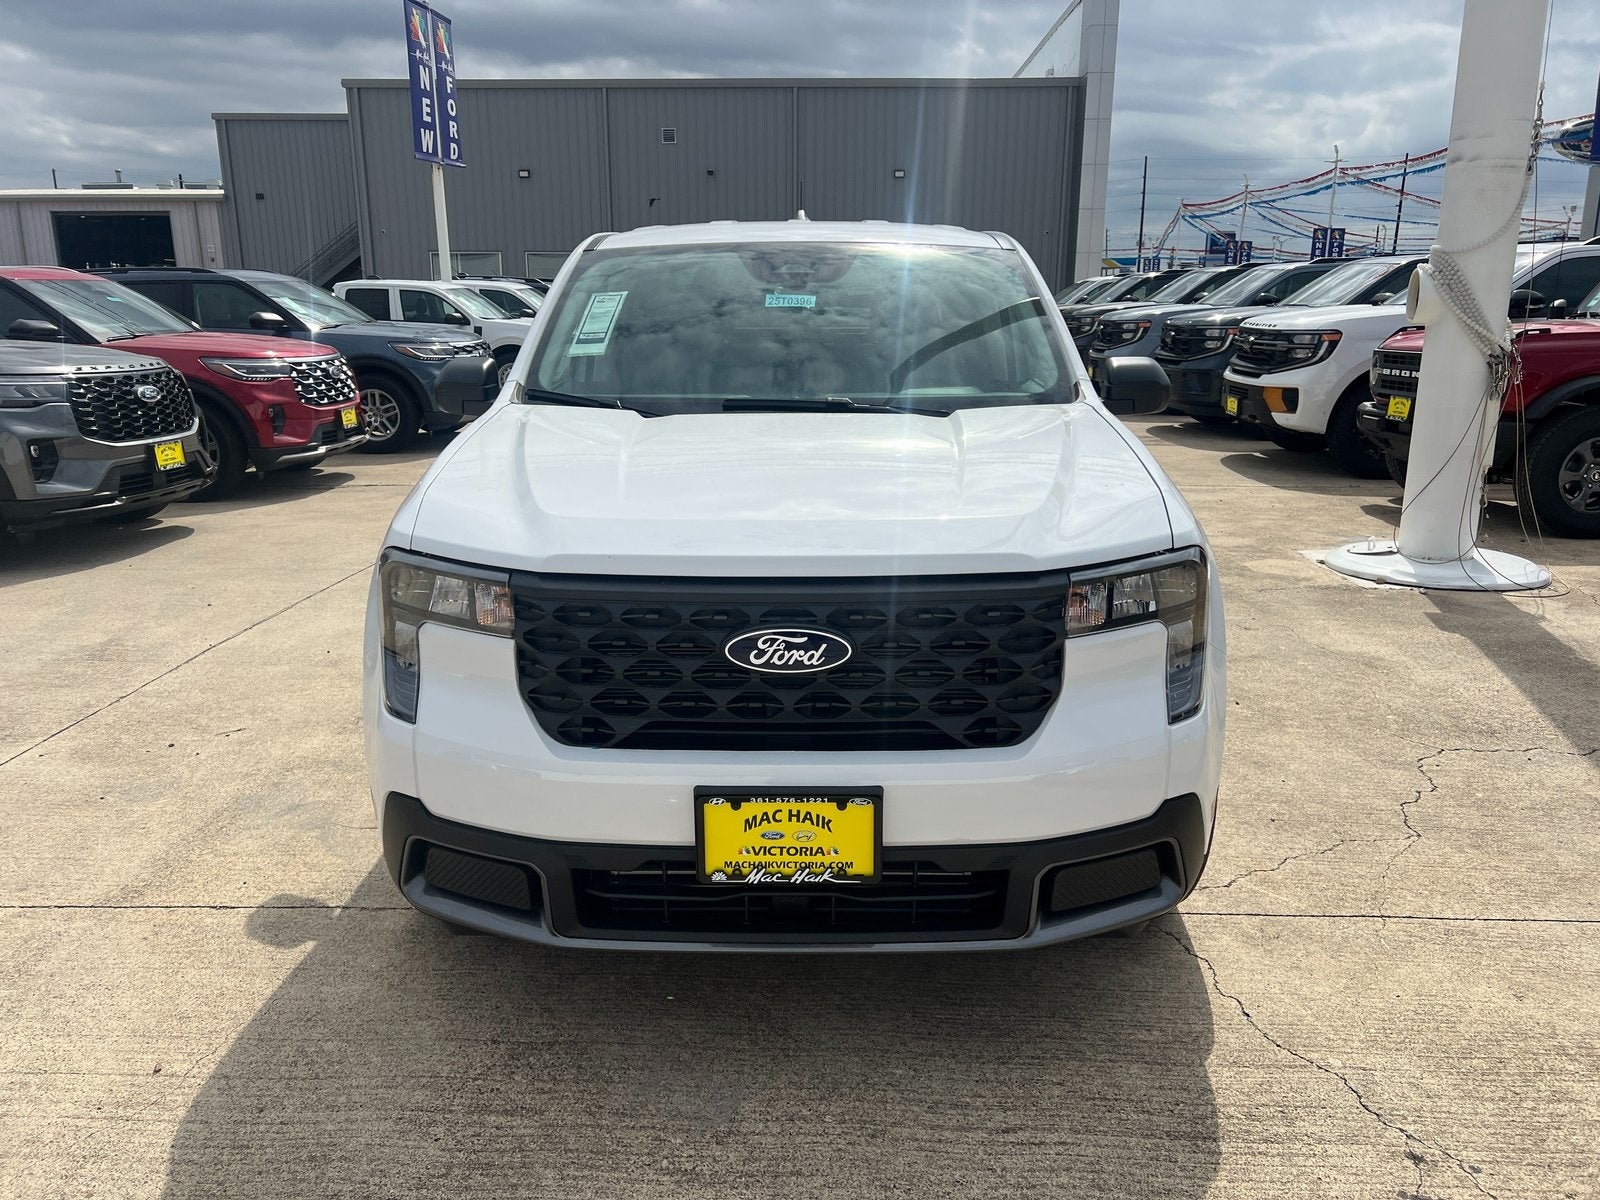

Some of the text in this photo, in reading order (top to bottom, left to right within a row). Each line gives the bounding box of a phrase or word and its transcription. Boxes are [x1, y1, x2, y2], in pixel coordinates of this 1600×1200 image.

[419, 64, 434, 154] NEW
[445, 76, 459, 161] FORD
[767, 297, 813, 306] 25T0396
[749, 635, 828, 665] Ford
[743, 809, 833, 833] MAC HAIK
[750, 846, 826, 857] VICTORIA
[723, 861, 854, 869] MACHAIKVICTORIA.COM
[744, 868, 837, 884] Mac Haik
